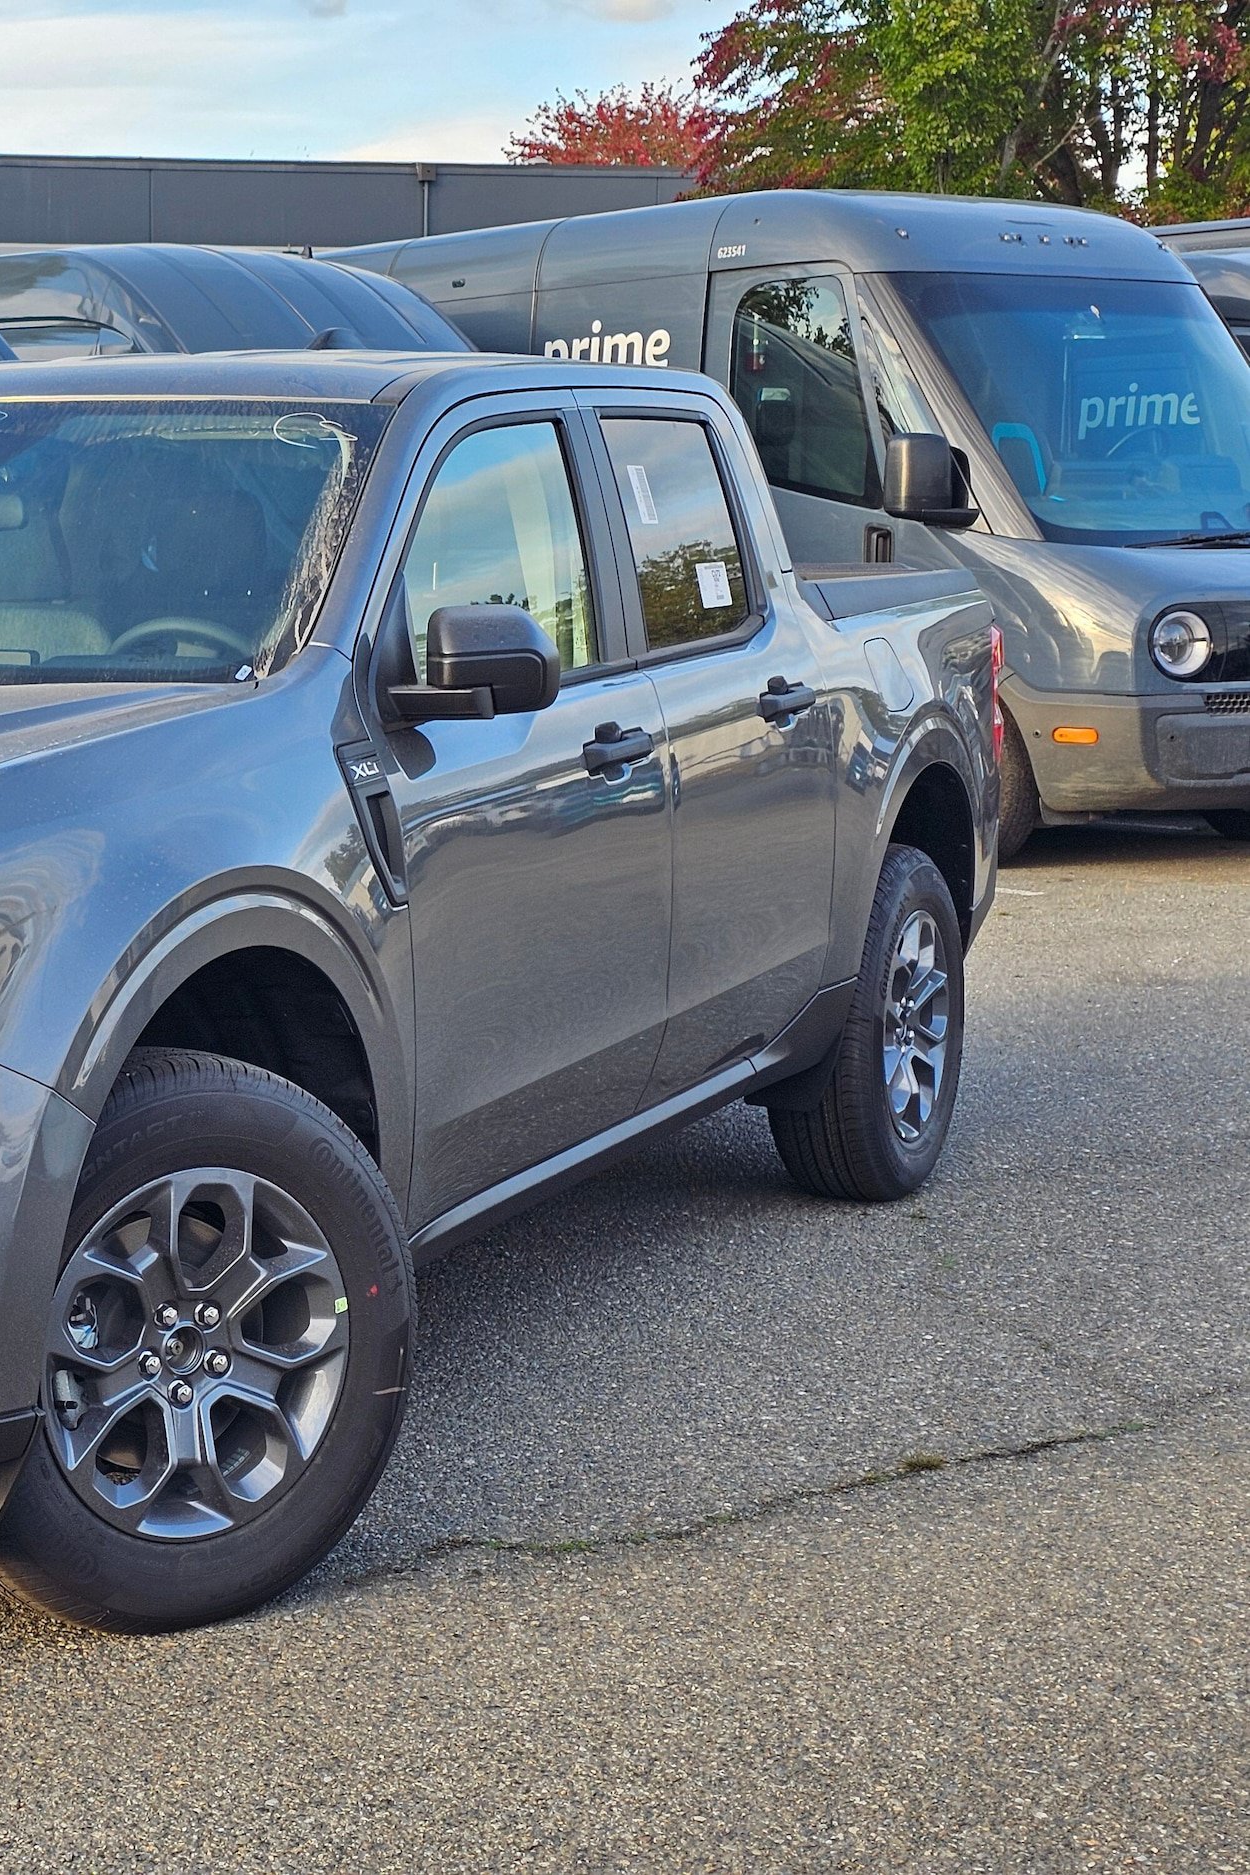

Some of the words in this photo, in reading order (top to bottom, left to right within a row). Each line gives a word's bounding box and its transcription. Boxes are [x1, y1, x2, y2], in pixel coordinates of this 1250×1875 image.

[717, 245, 746, 259] 623541
[1078, 383, 1200, 440] prime
[350, 761, 379, 780] XLT
[307, 1136, 400, 1275] Continental
